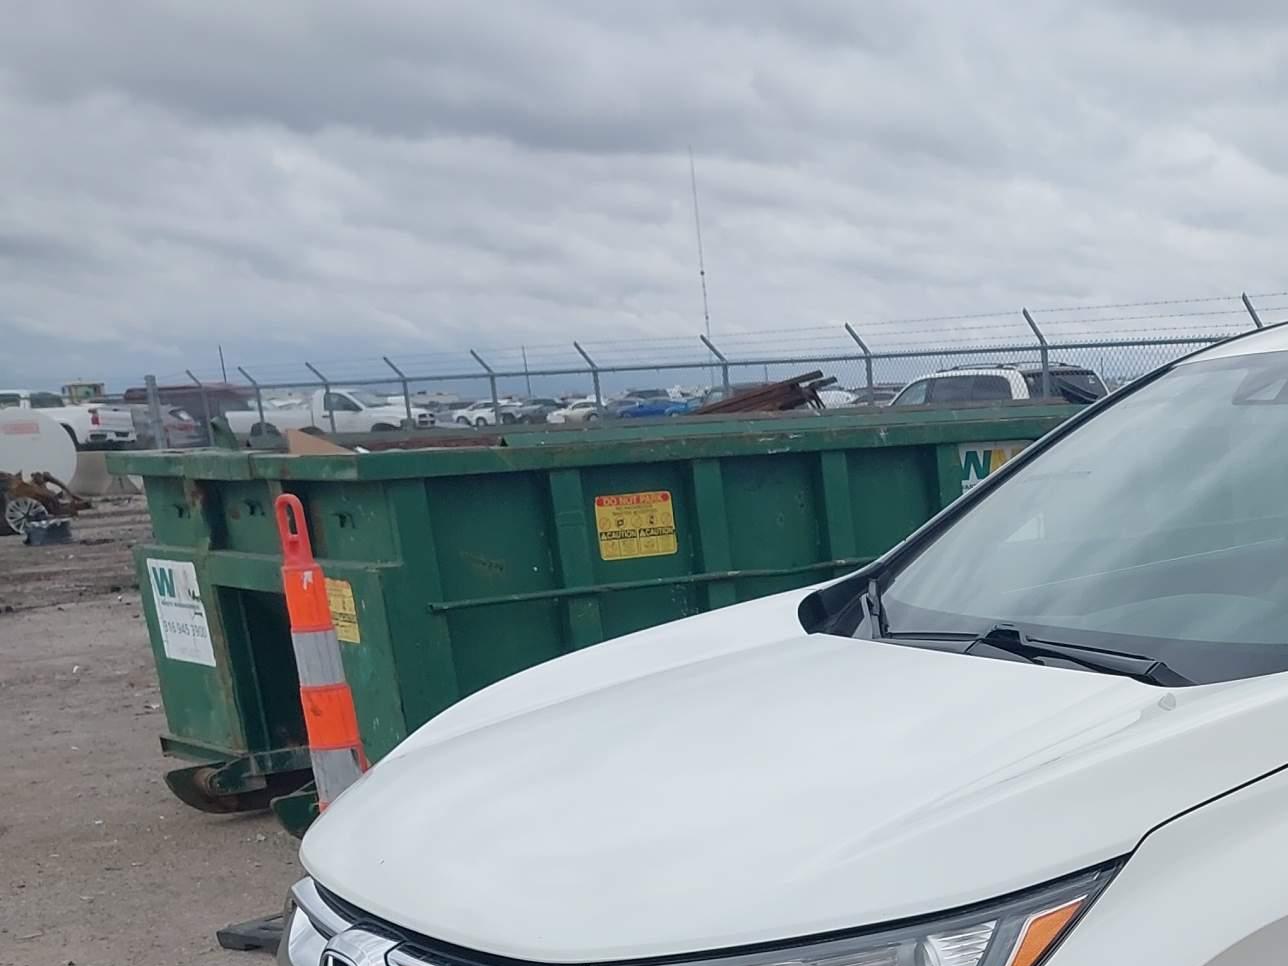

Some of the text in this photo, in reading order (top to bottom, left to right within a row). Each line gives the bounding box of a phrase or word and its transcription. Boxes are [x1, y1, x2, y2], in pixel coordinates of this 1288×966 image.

[604, 498, 616, 506] DO
[619, 495, 637, 505] NOT
[607, 530, 637, 539] CAUTION
[646, 528, 673, 536] CAUTION
